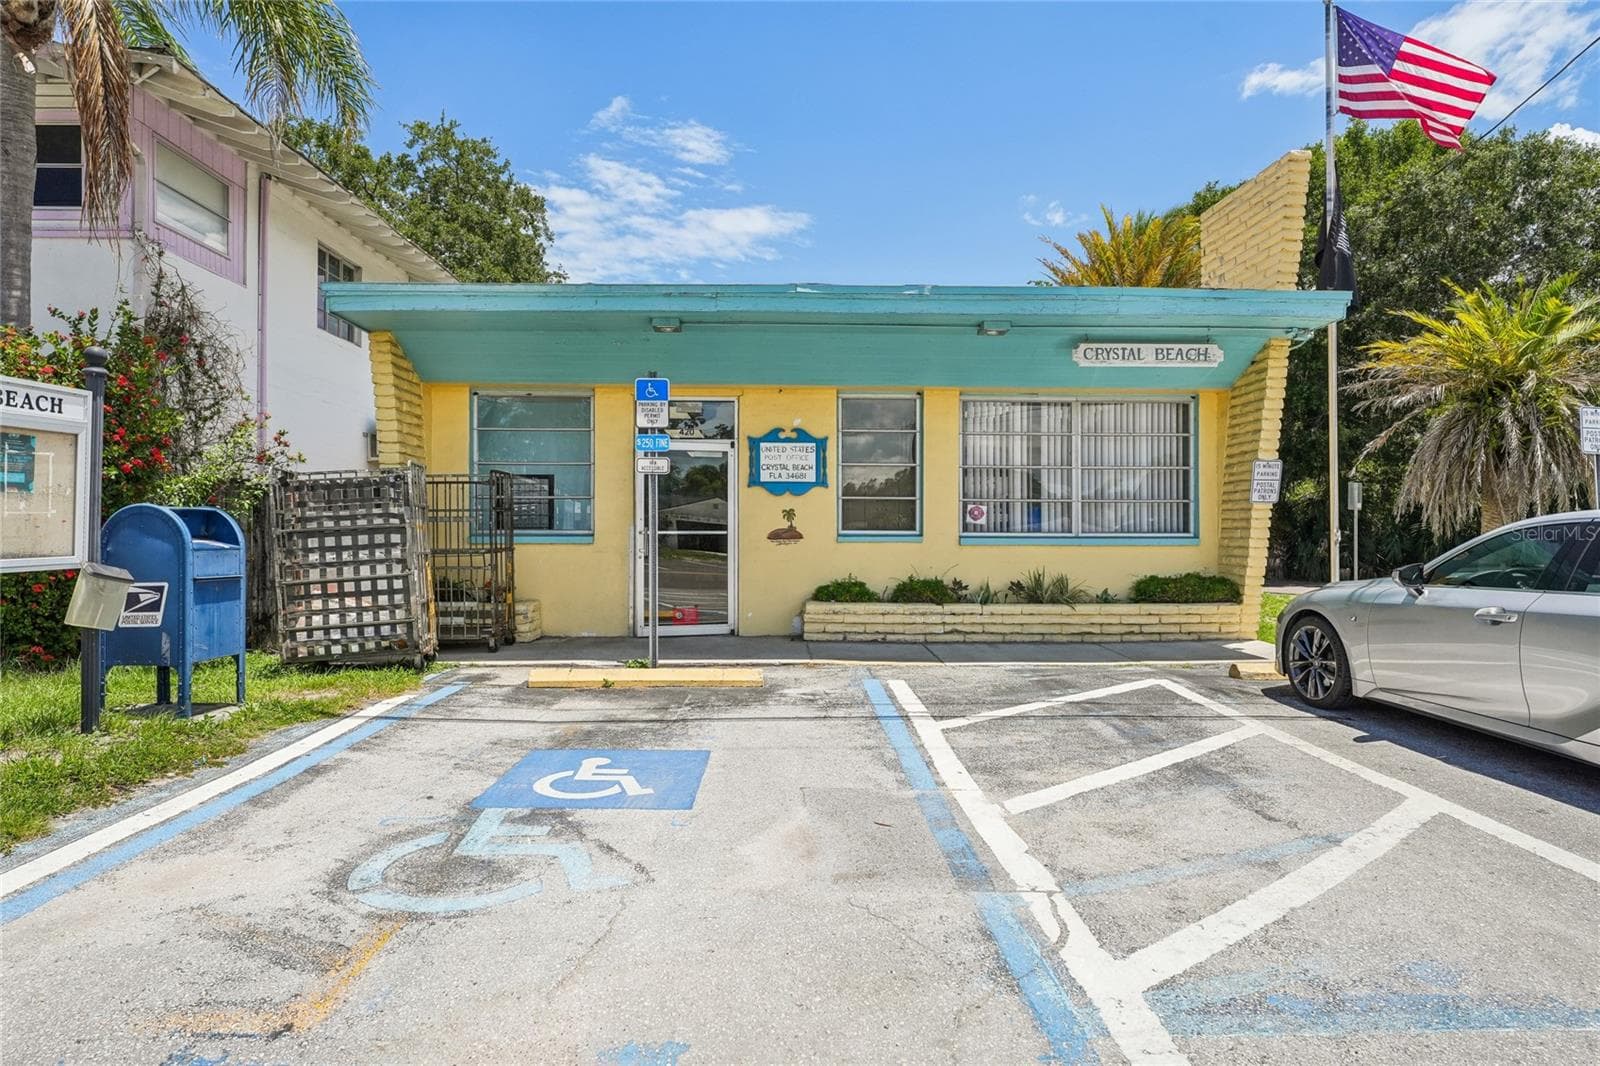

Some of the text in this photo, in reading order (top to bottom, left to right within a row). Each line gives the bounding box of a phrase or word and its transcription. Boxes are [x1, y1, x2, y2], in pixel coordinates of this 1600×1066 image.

[1083, 347, 1209, 361] CRYSTAL BEACH
[637, 438, 669, 448] $250 FINE
[761, 463, 813, 471] CRYSTAL BEACH
[769, 472, 807, 480] FLA 34681
